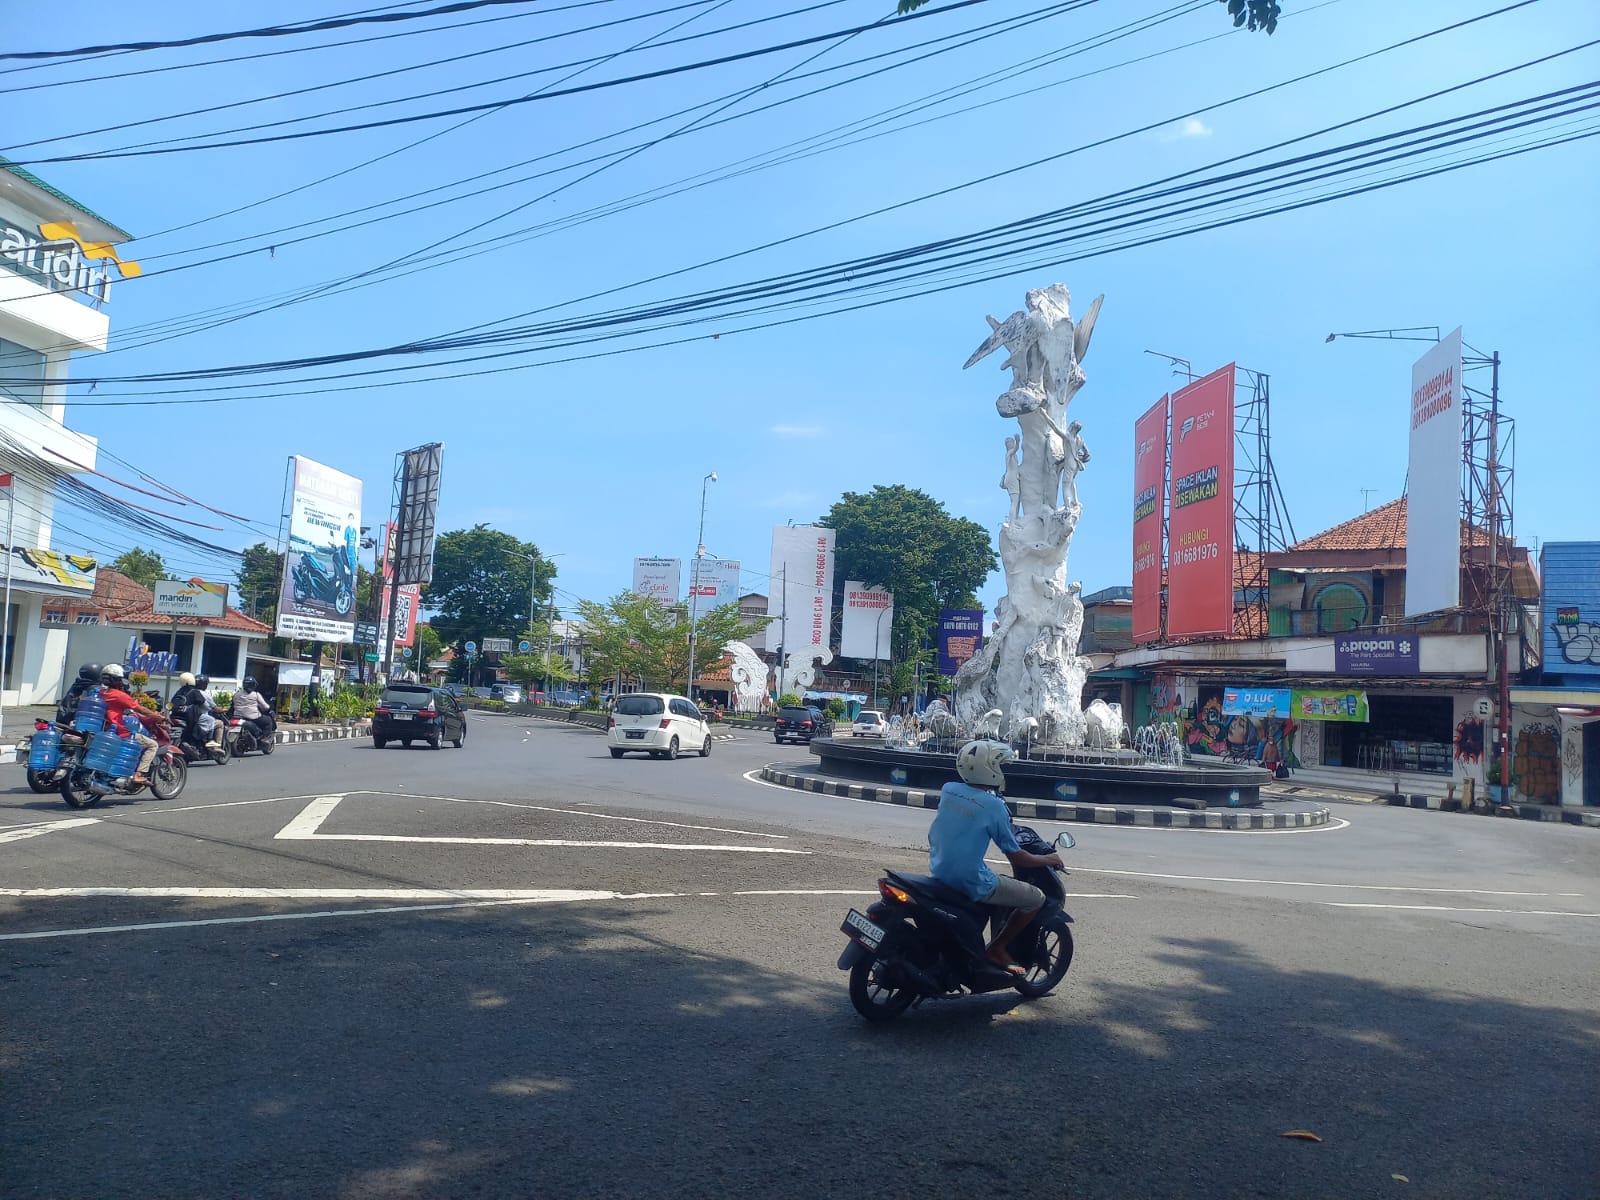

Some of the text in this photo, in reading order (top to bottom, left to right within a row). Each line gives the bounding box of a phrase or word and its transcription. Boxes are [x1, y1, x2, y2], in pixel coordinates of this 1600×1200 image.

[0, 227, 112, 304] andiri
[1176, 466, 1218, 492] SPACE IKLAN
[1175, 482, 1218, 508] DISEWAKAN
[1179, 528, 1209, 547] HUBUNGI
[1350, 640, 1395, 652] propan
